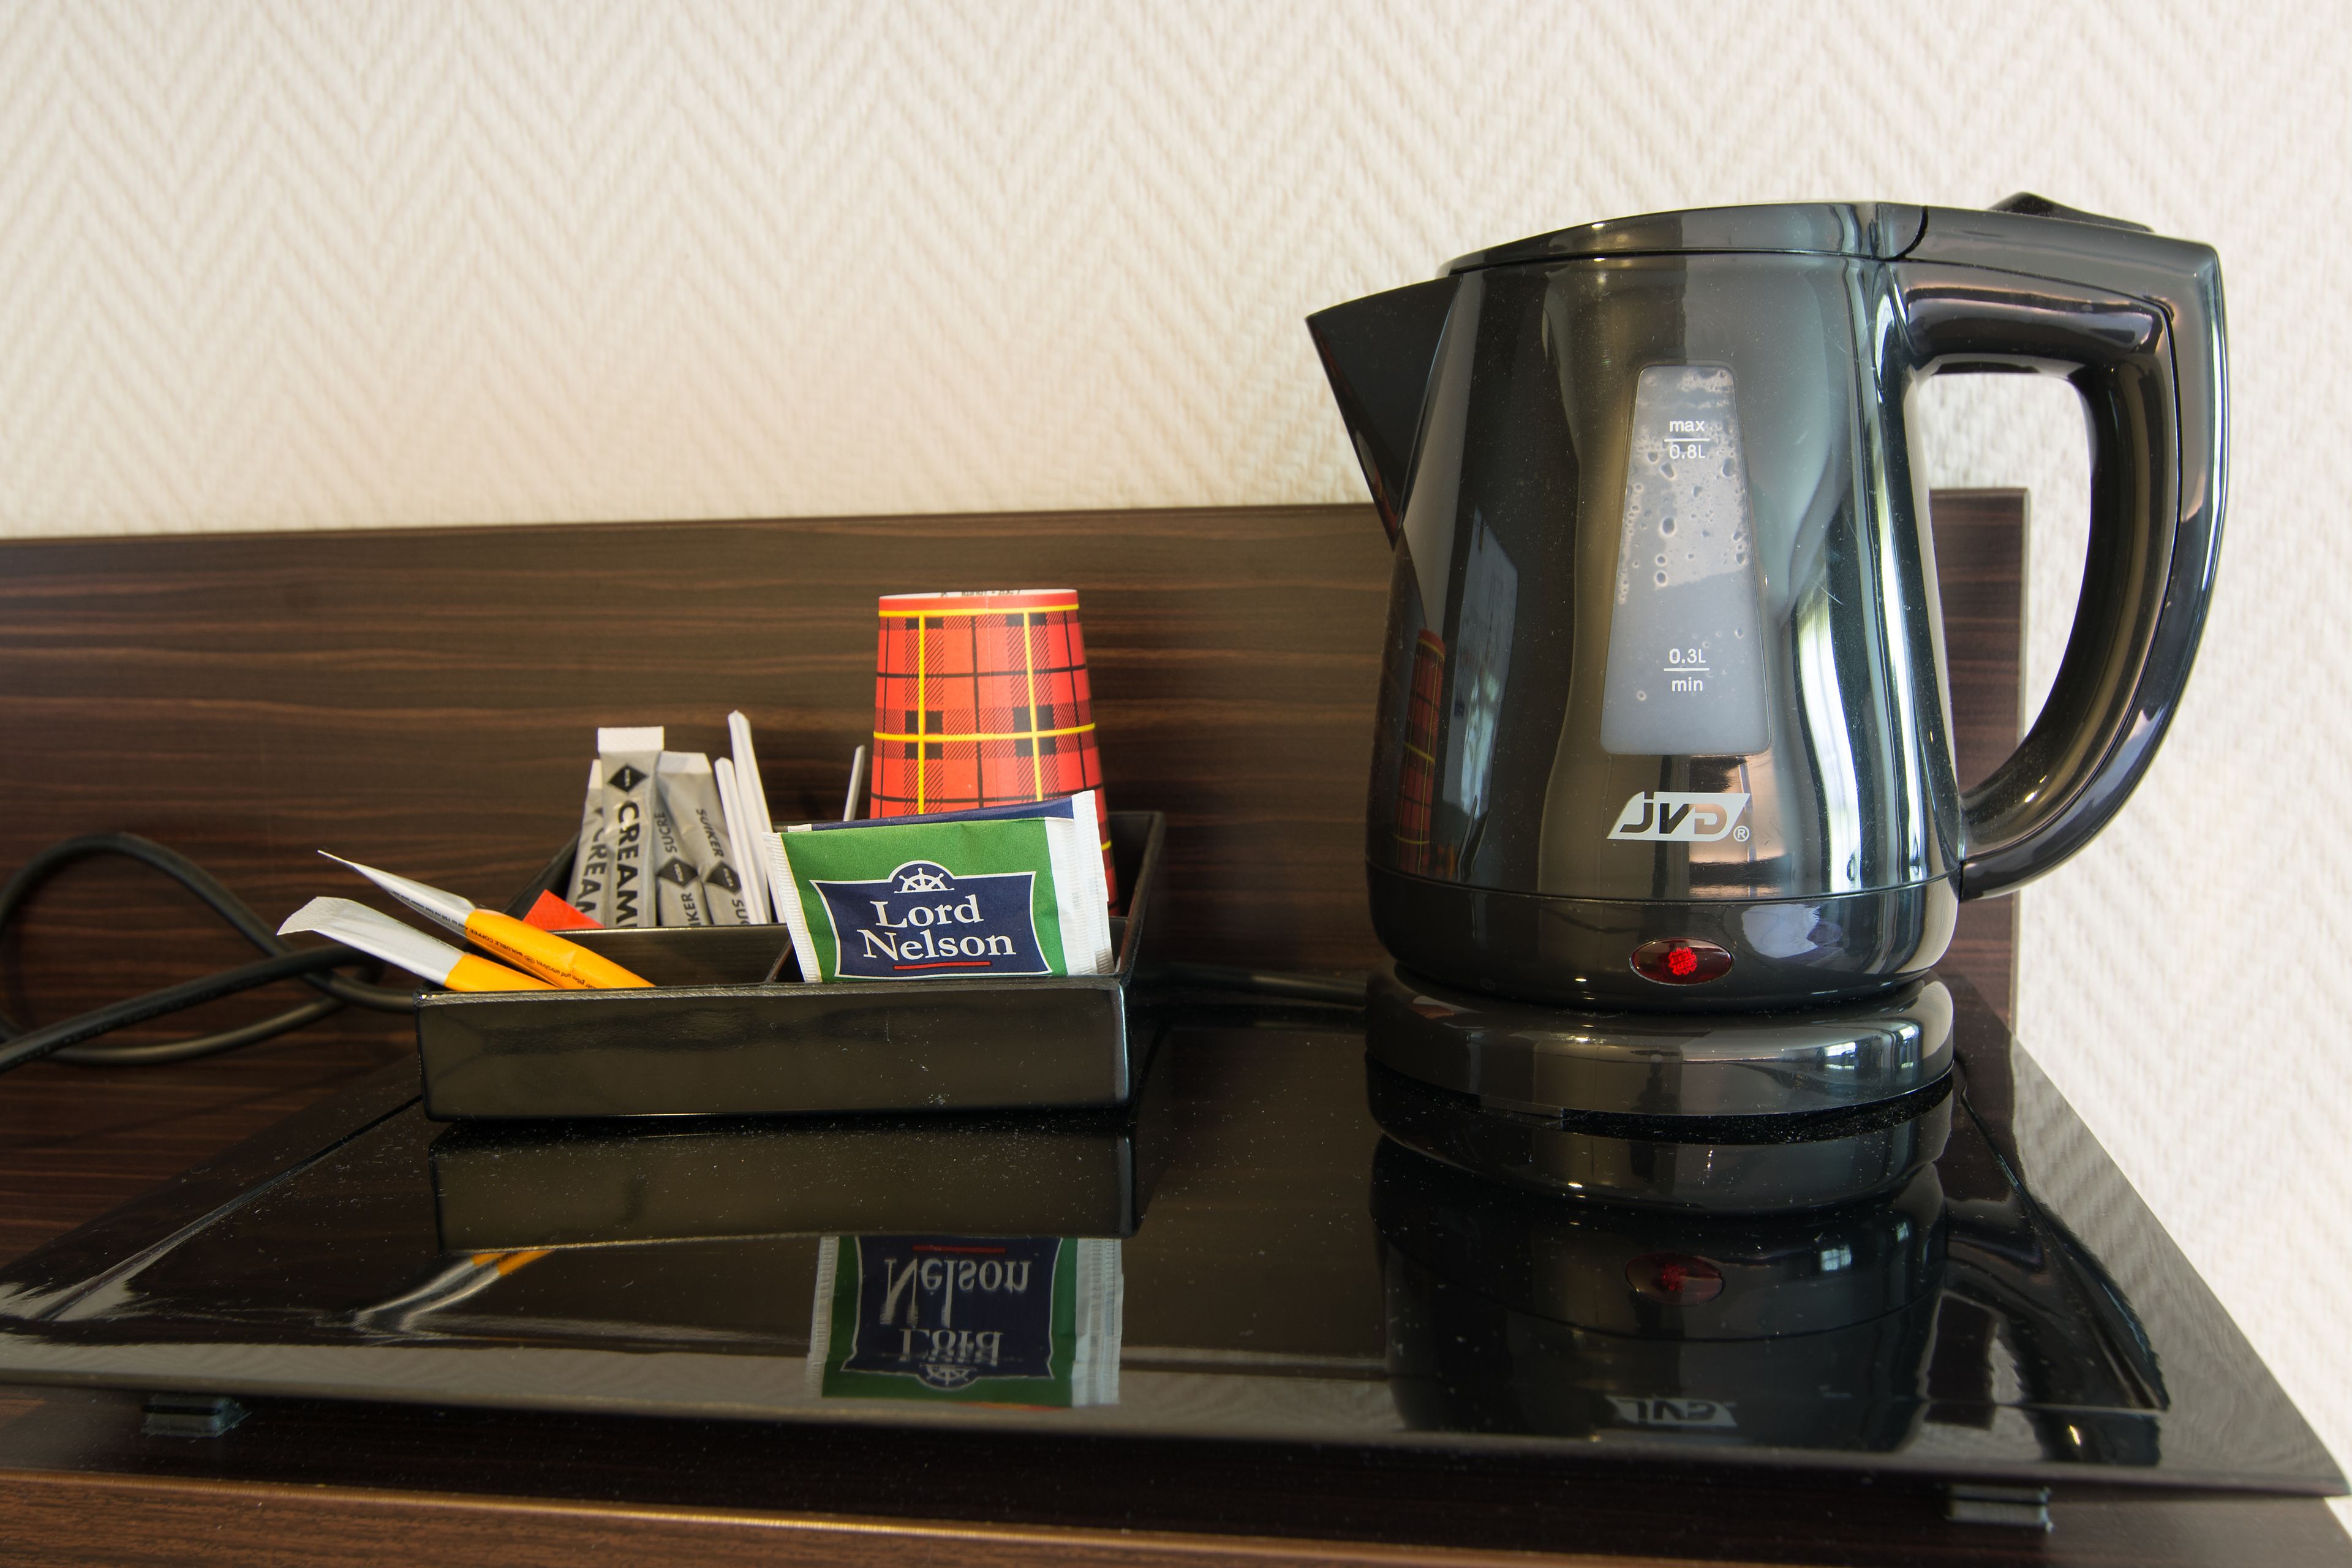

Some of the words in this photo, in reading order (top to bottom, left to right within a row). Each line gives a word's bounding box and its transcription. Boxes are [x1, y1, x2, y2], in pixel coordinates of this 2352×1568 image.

[1668, 419, 1705, 432] max
[1668, 443, 1706, 459] 0.8L
[1668, 648, 1706, 664] 0.3L
[1671, 677, 1704, 692] min
[654, 812, 677, 853] SUCRE
[695, 809, 724, 857] SUIKER
[616, 801, 640, 927] CREAM
[869, 894, 984, 929] Lord
[469, 928, 494, 943] COFFEE
[494, 940, 523, 956] SOLUBLE
[856, 927, 1017, 961] Nelson
